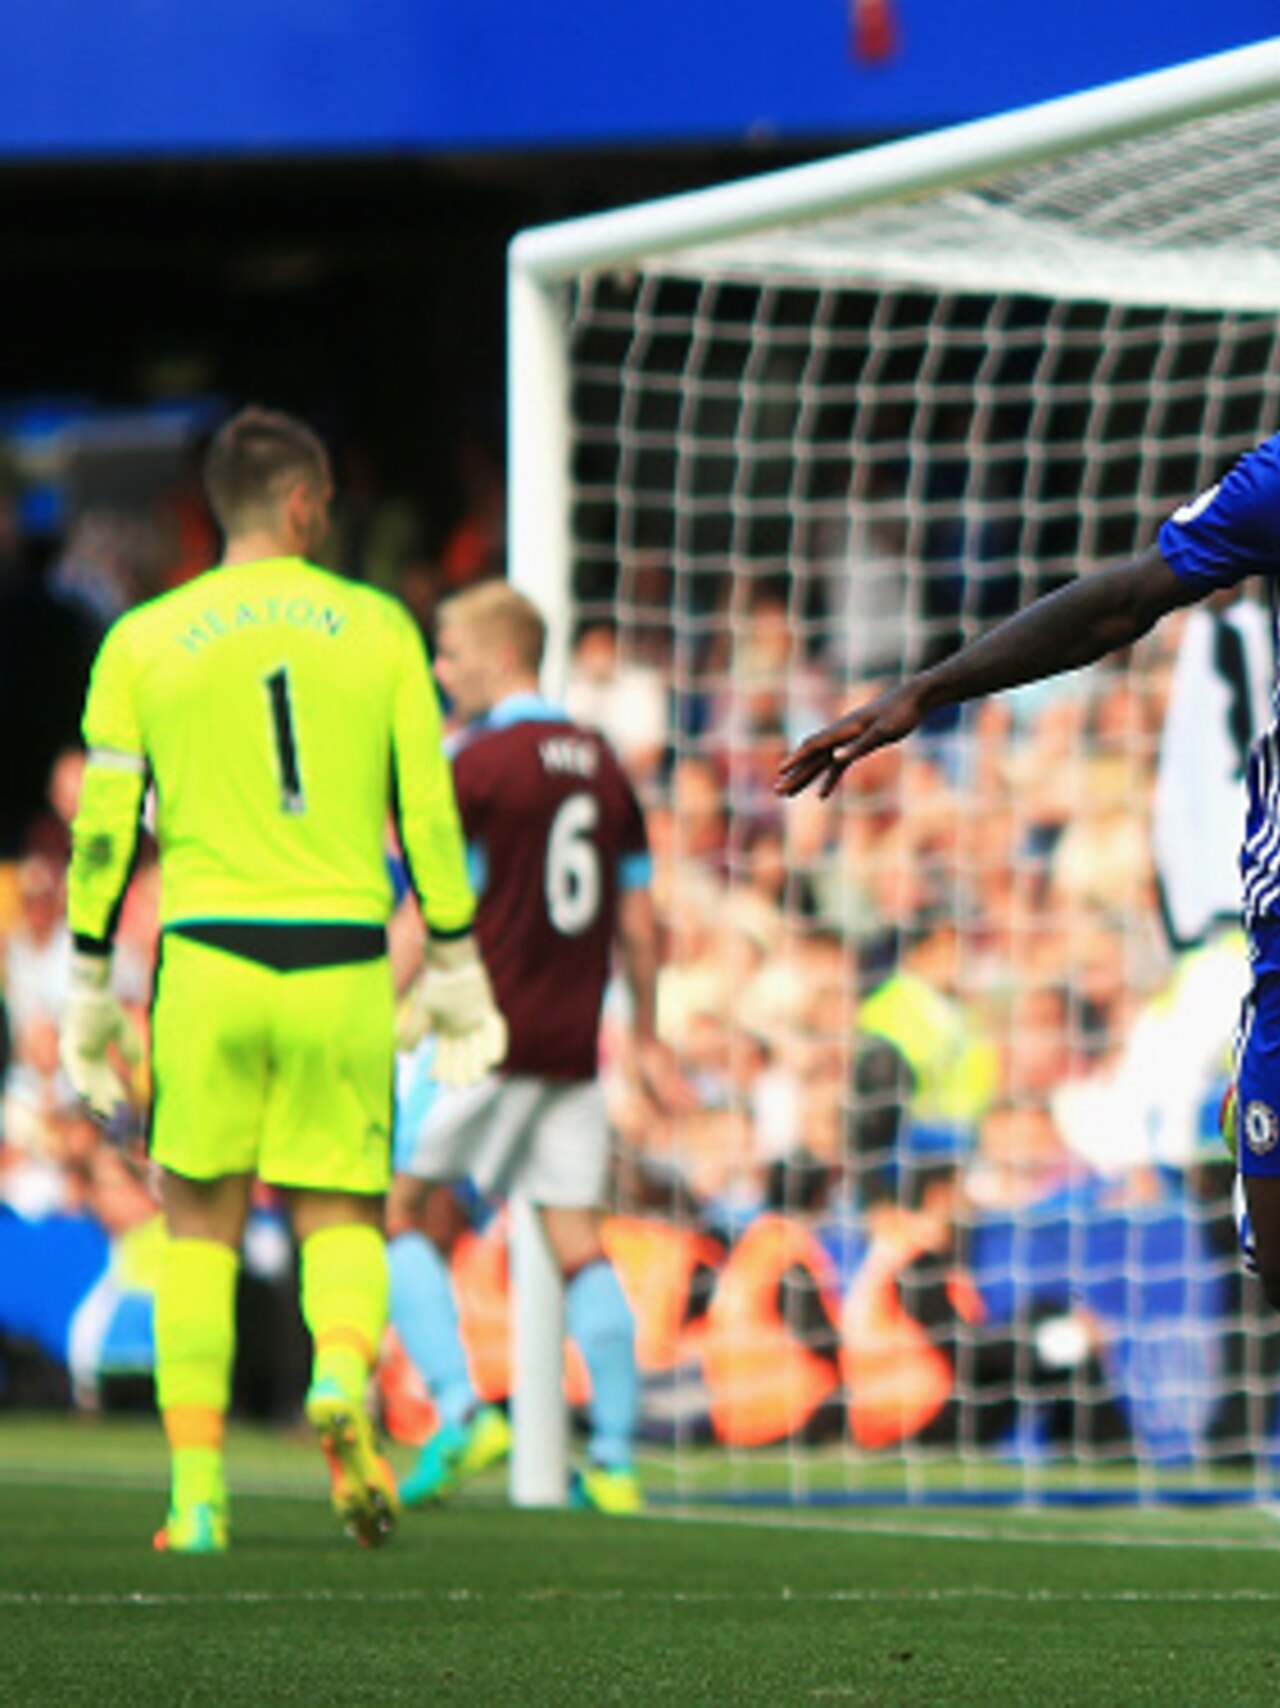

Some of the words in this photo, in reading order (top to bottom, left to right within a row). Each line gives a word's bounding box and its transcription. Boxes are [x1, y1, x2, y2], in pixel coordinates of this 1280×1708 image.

[179, 598, 348, 653] HEATON
[264, 664, 305, 814] 1
[546, 793, 601, 936] 6
